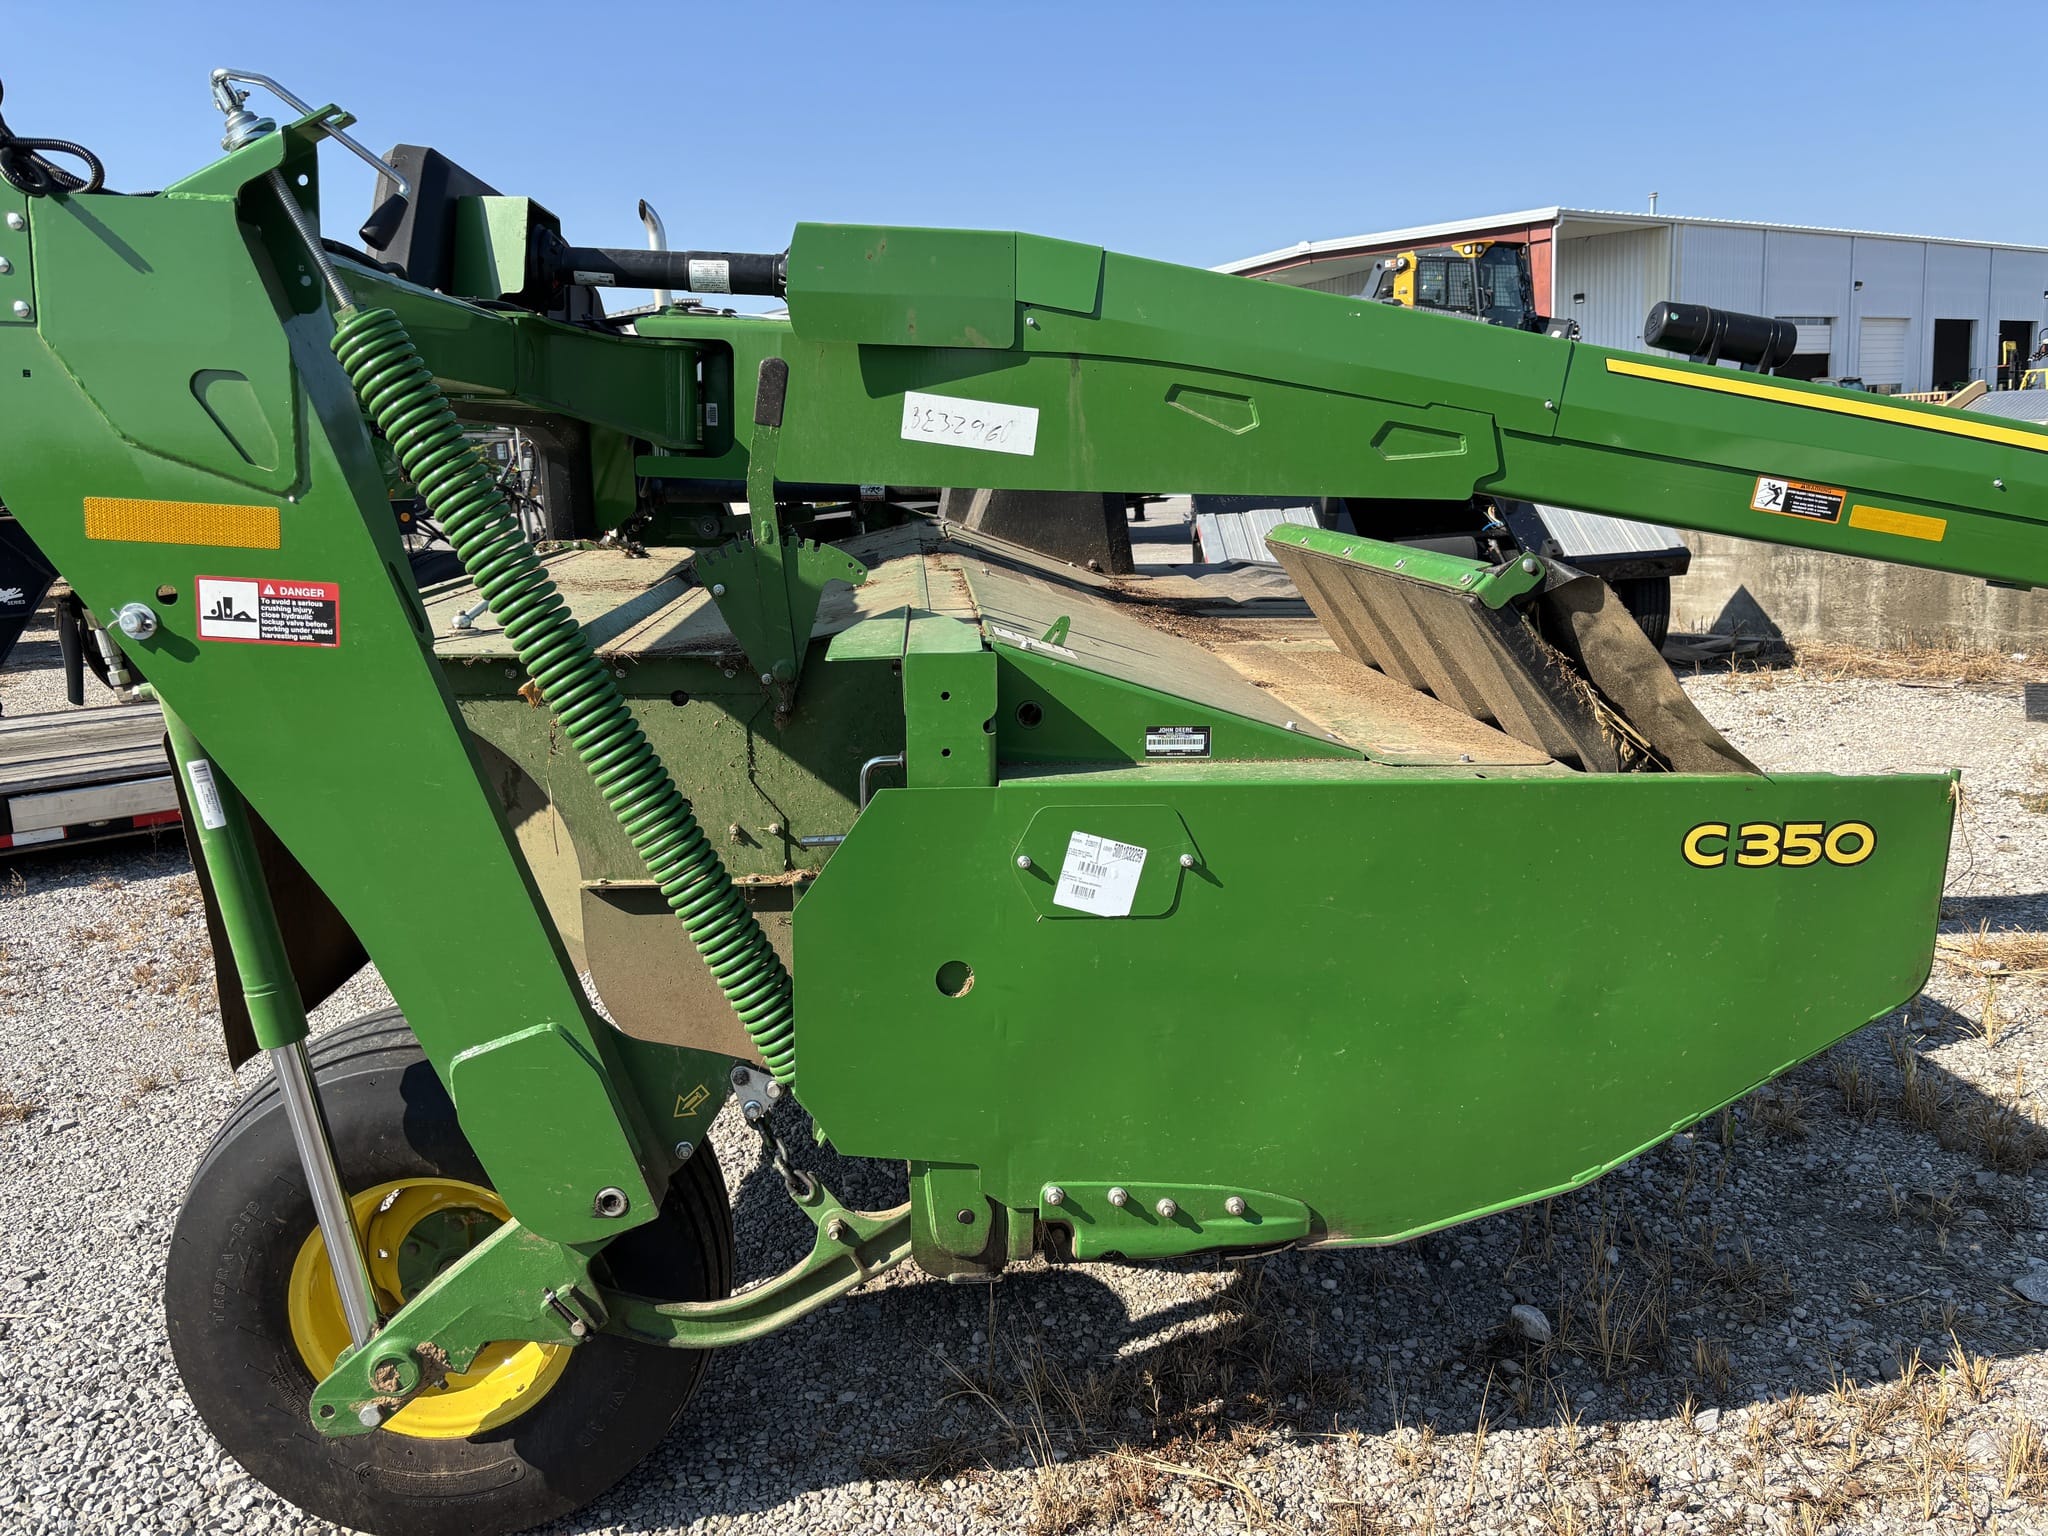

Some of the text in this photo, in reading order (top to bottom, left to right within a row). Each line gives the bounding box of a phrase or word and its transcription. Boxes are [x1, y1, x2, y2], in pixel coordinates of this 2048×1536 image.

[279, 586, 325, 598] DANGER
[297, 600, 324, 608] serious
[260, 605, 292, 615] crushing
[281, 612, 314, 621] hydraulic
[261, 618, 285, 626] lockup
[305, 620, 328, 628] before
[261, 626, 290, 634] working
[261, 632, 298, 641] harvesting
[1681, 820, 1877, 868] C350
